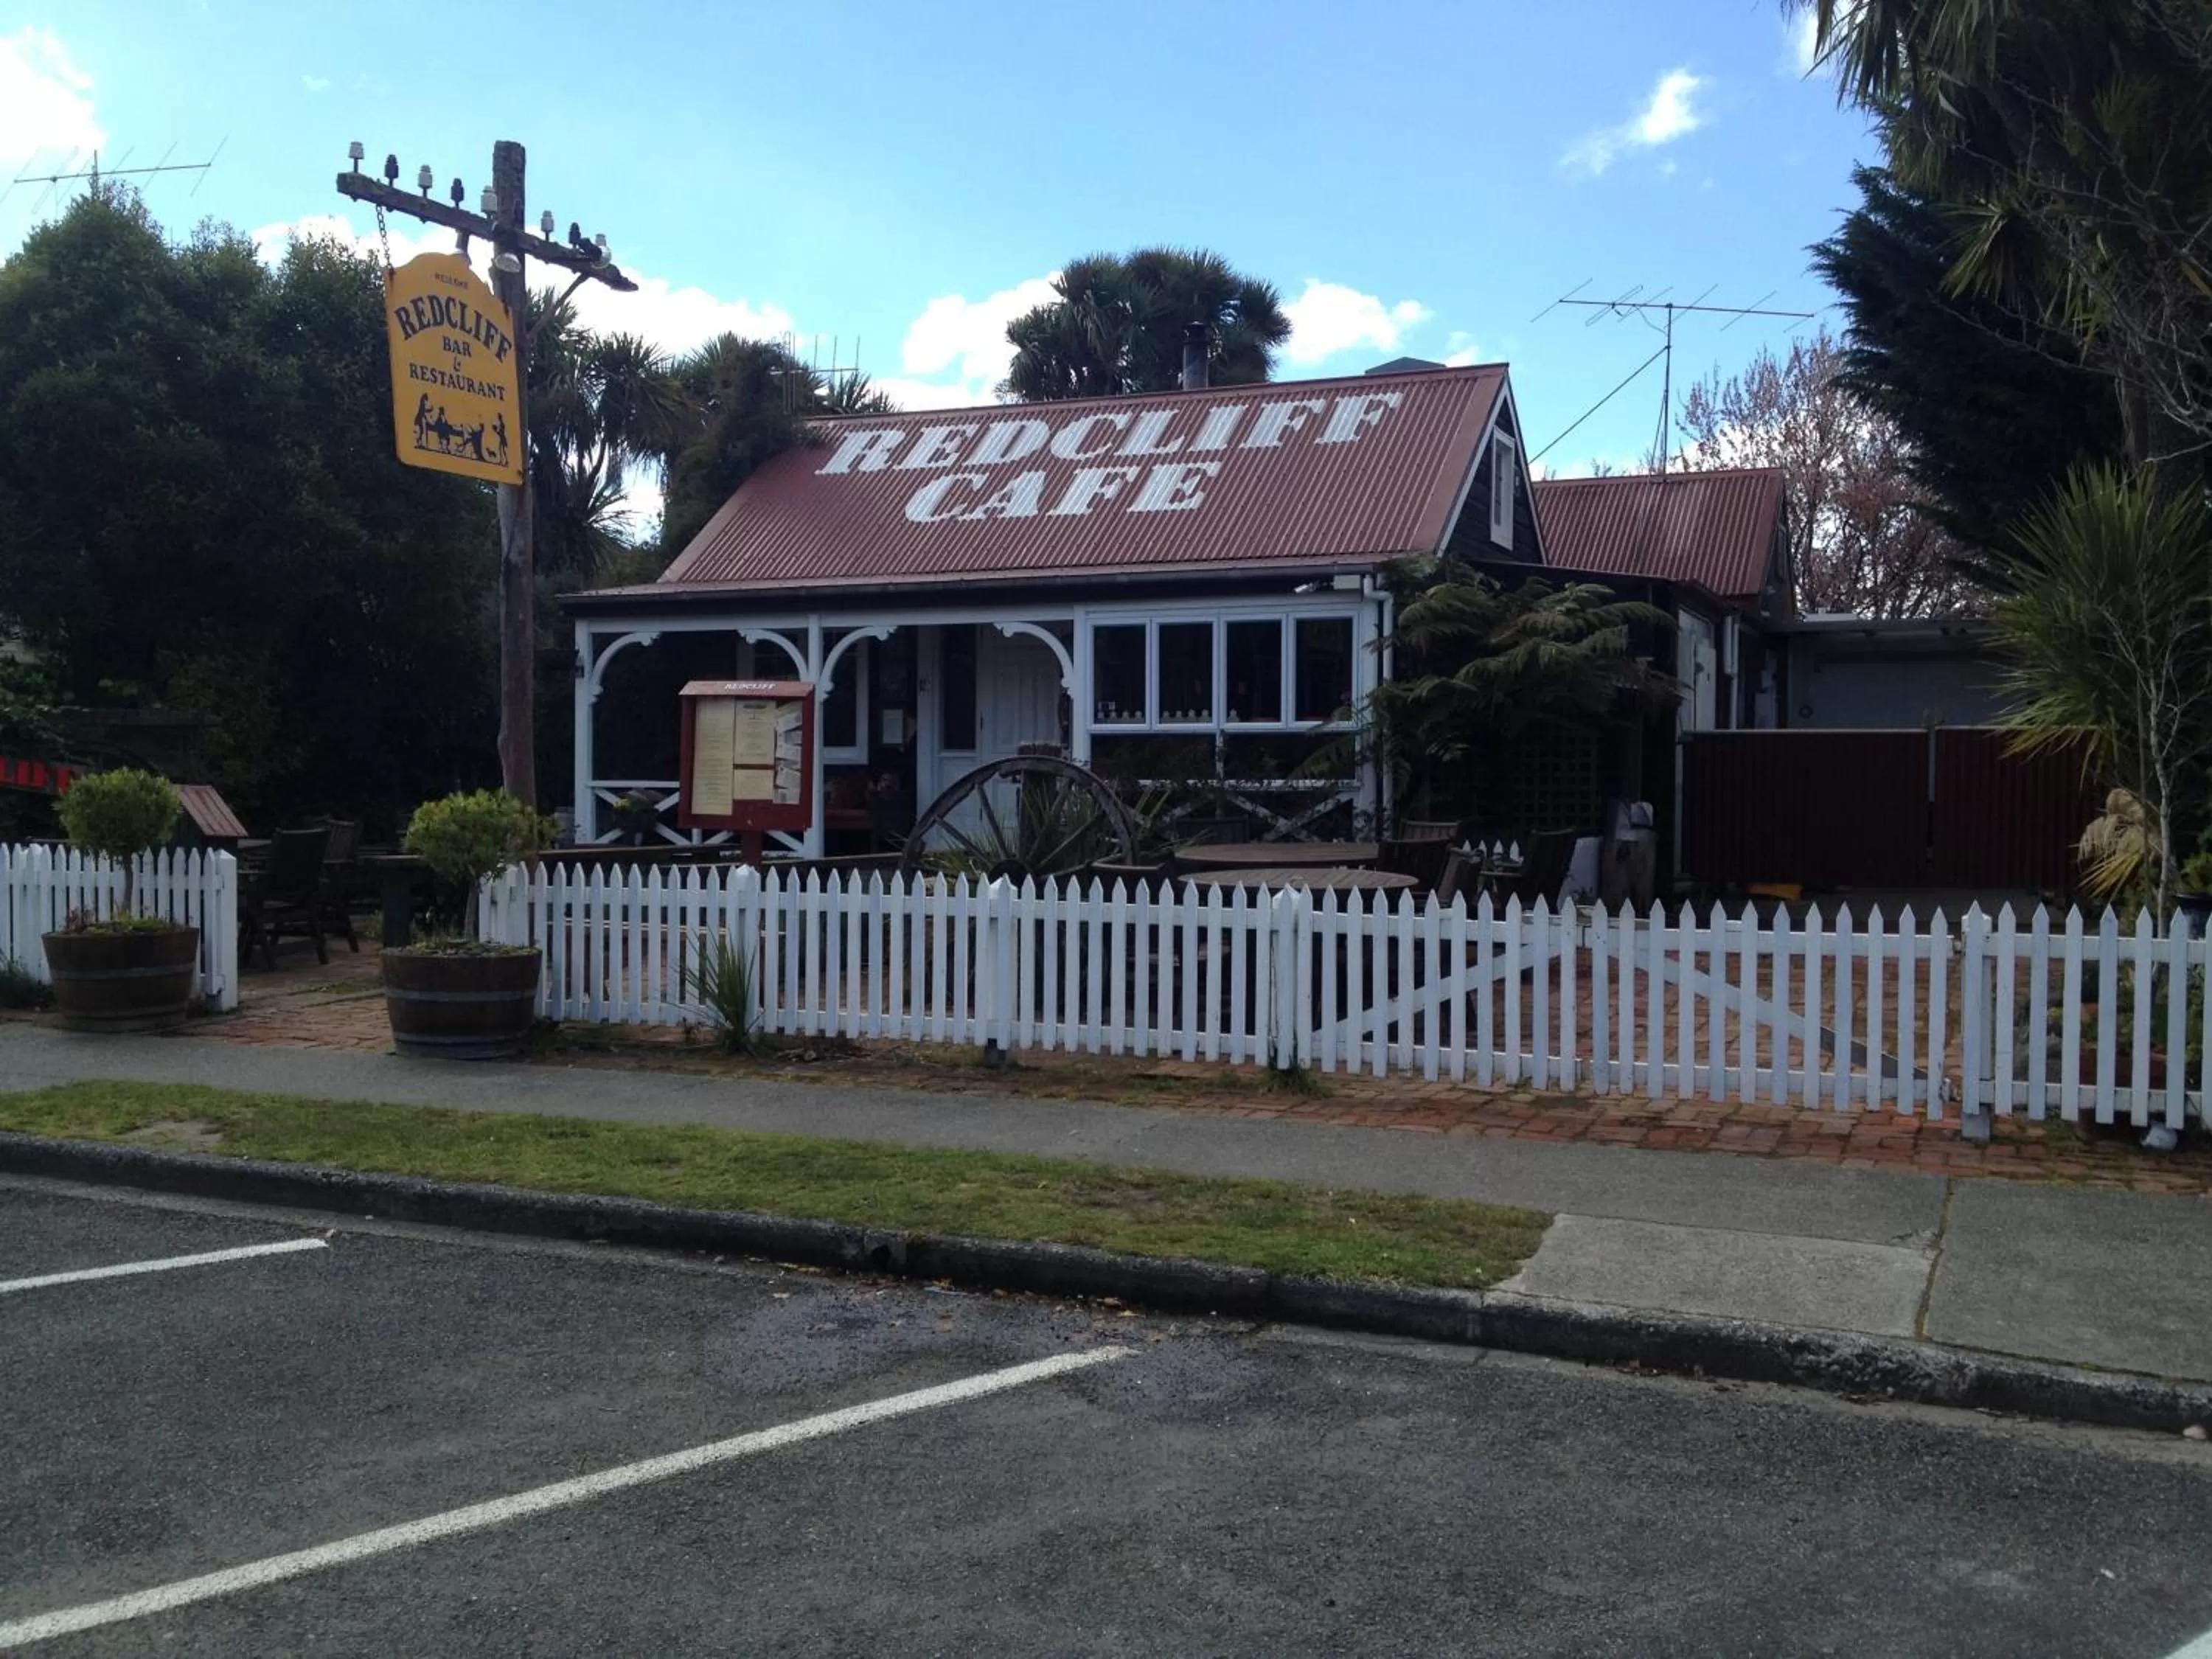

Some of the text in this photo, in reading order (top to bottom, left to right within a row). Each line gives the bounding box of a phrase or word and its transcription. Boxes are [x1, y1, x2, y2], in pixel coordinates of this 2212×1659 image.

[394, 295, 512, 364] REDCLIFF
[443, 335, 472, 358] BAR
[410, 363, 505, 401] RESTAURANT
[815, 392, 1404, 475] REDCLIFF
[904, 461, 1222, 523] CAFE
